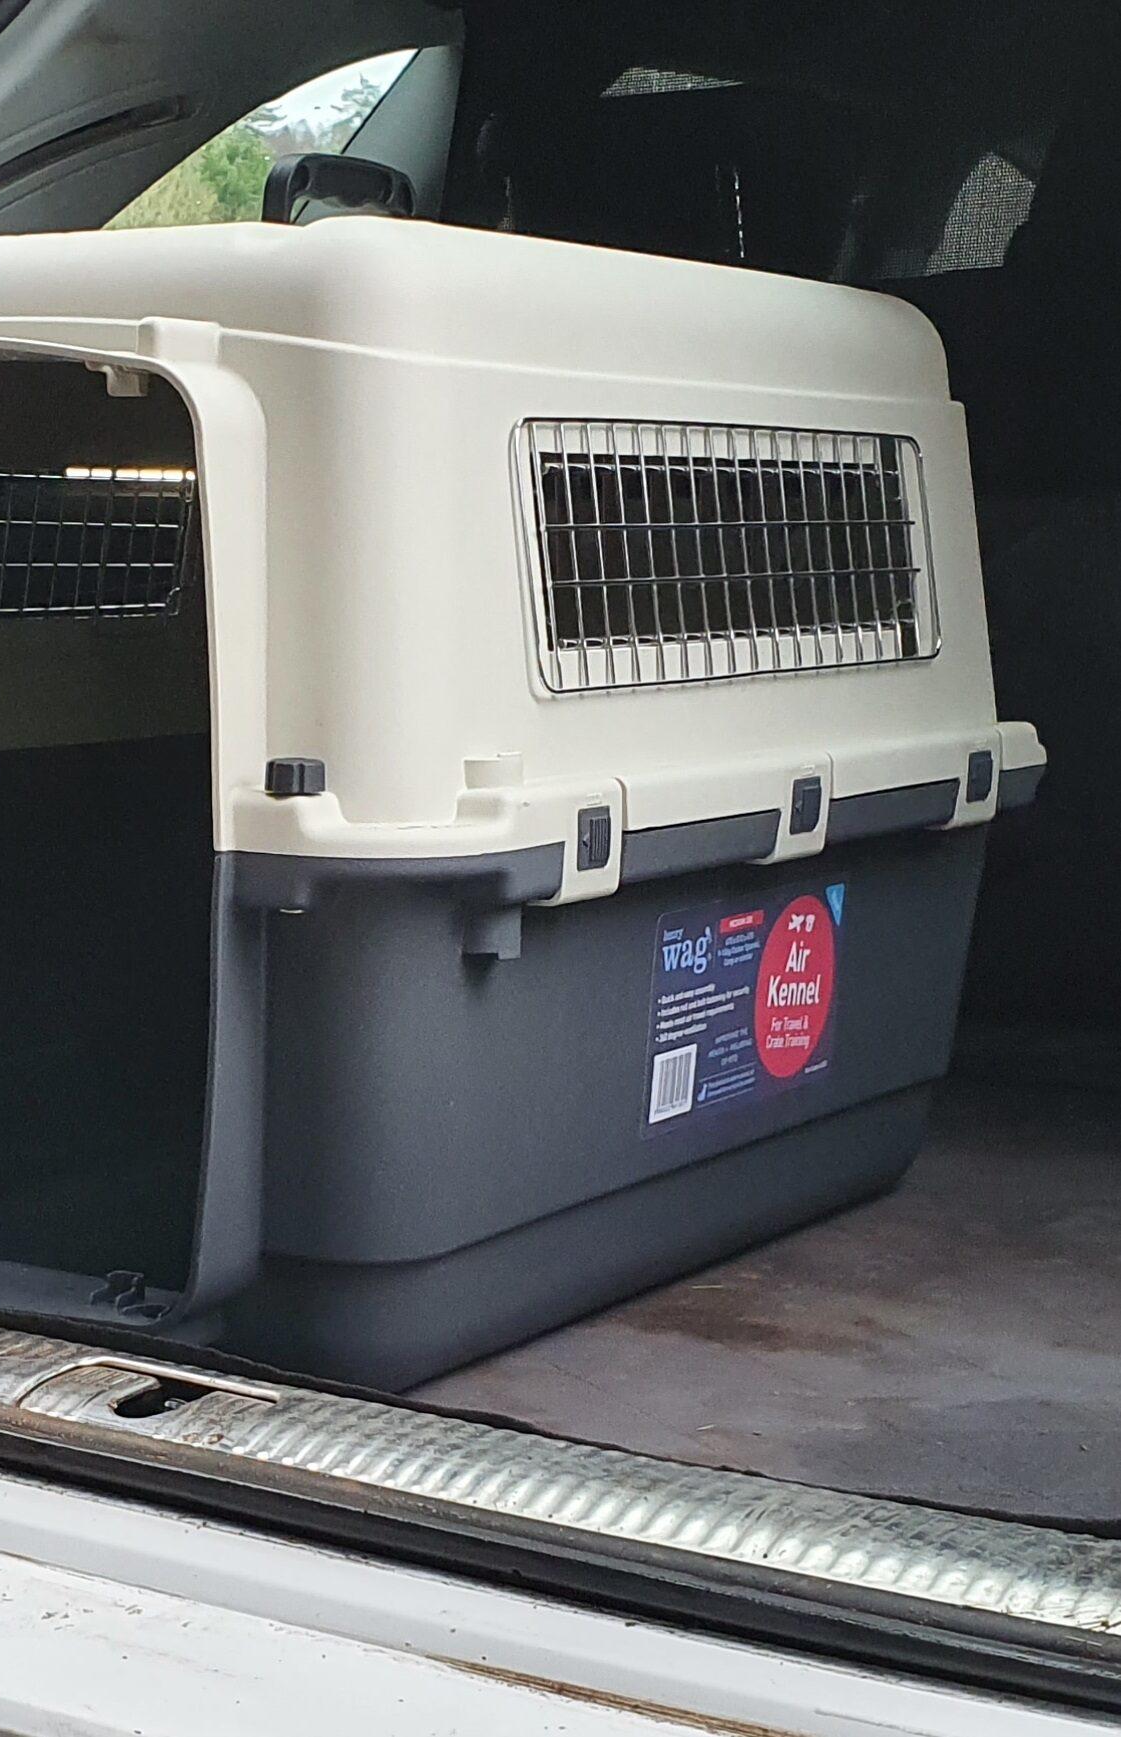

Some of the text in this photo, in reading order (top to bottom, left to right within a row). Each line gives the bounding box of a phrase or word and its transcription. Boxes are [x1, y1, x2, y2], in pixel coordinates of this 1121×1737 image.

[662, 926, 712, 974] wag
[785, 940, 811, 972] Air
[767, 974, 821, 1008] Kennel
[771, 1016, 783, 1031] For
[784, 1016, 802, 1031] Travel
[766, 1035, 784, 1049] Crate
[785, 1032, 810, 1050] Training
